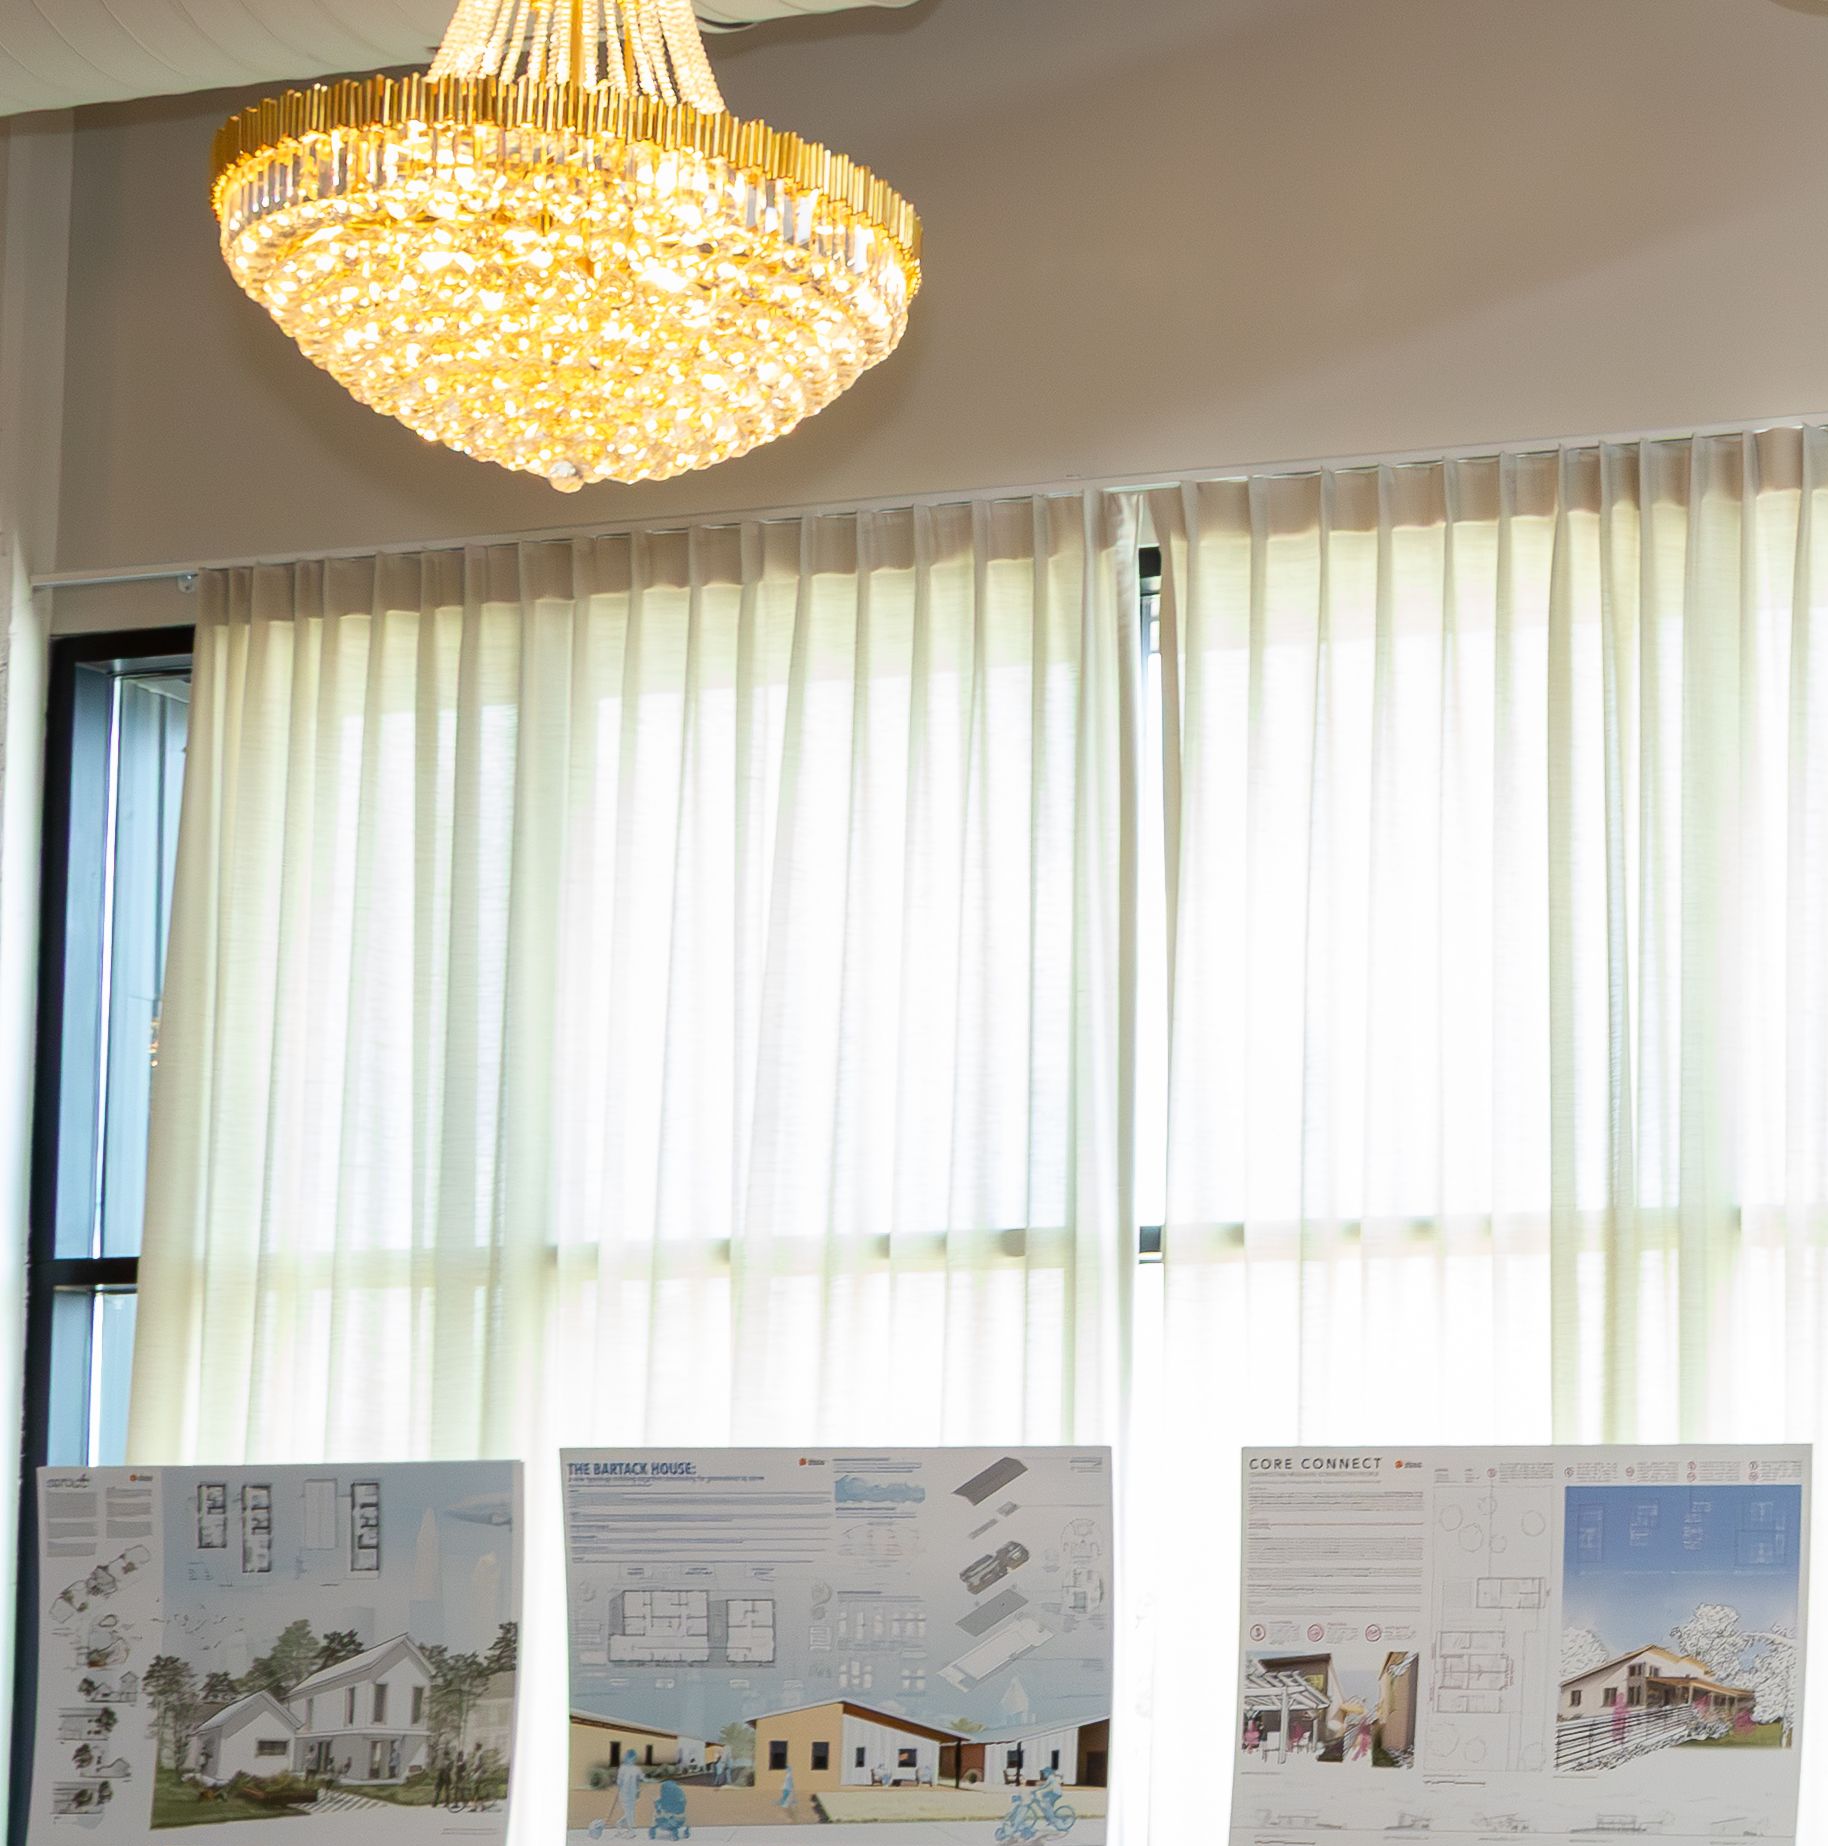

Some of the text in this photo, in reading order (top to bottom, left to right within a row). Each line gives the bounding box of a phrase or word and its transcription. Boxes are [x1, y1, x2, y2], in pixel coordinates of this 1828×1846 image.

[567, 1462, 697, 1476] THE BARTACK HOUSE:
[1249, 1457, 1383, 1471] CORE CONNECT
